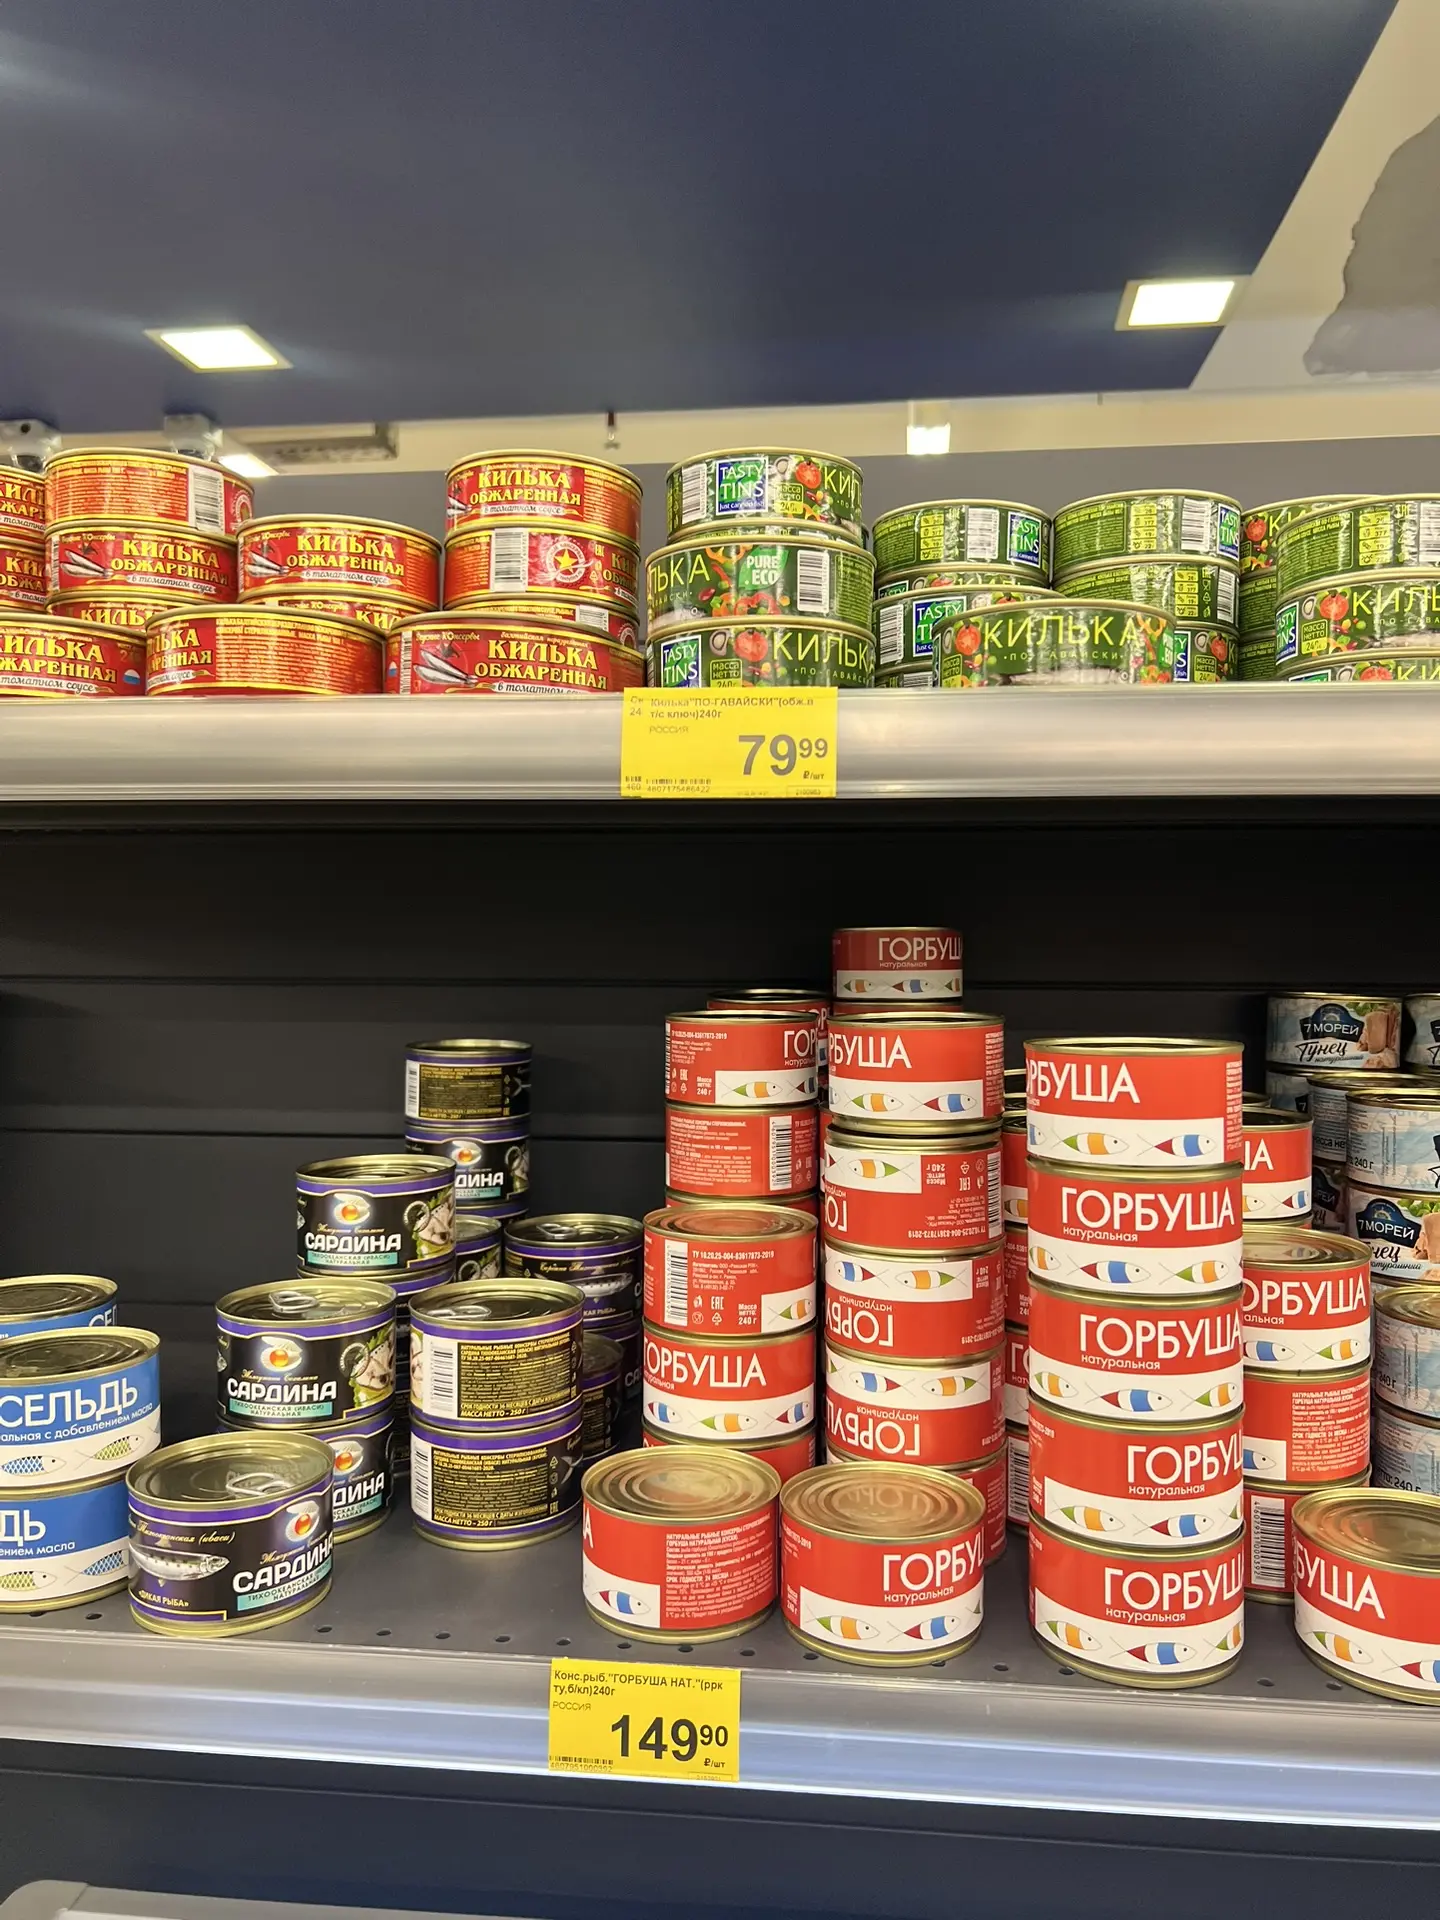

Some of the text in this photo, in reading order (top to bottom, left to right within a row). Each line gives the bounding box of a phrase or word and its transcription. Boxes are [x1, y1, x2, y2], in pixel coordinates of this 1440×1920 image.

[478, 470, 571, 489] КИЛЬКА
[720, 464, 764, 480] TASTY
[470, 489, 581, 506] ОБЖАРЕННАЯ
[719, 481, 765, 500] TINS
[490, 506, 536, 514] томатном
[297, 535, 396, 560] КИЛЬКА
[1011, 533, 1041, 554] TINS
[123, 540, 219, 568] КИЛЬКА
[746, 555, 781, 568] PURE
[111, 558, 228, 586] ОБЖАРЕННАЯ
[286, 554, 405, 577] ОБЖАРЕННАЯ
[139, 575, 190, 589] томатном
[312, 571, 364, 581] томатном
[751, 570, 778, 585] ECO
[984, 615, 1139, 650] КИЛЬКА
[1303, 623, 1326, 634] масса
[488, 639, 598, 670] КИЛЬКА
[663, 644, 698, 662] TASTY
[474, 662, 608, 691] ОБЖАРЕННАЯ
[663, 661, 699, 686] TINS
[667, 709, 723, 720] ключ)240г
[649, 725, 689, 735] РОССИЯ
[879, 961, 929, 971] натуральная
[1303, 1022, 1360, 1036] 7 МОРЕЙ
[1295, 1040, 1349, 1063] Тунец
[1061, 1186, 1235, 1234] ГОРБУША
[1063, 1226, 1139, 1243] натуральная
[1365, 1220, 1415, 1241] МОРЕЙ
[304, 1233, 402, 1253] САРДИНА
[711, 1295, 725, 1311] EAC
[738, 1303, 758, 1311] Масса
[838, 1295, 893, 1312] натуральная
[738, 1316, 752, 1325] 240
[1079, 1307, 1242, 1359] ГОРБУША
[1081, 1353, 1161, 1371] натуральная
[227, 1377, 337, 1404] САРДИНА
[0, 1377, 138, 1428] СЕЛЬДЬ
[54, 1413, 131, 1441] добавлением
[131, 1402, 154, 1419] масла
[250, 1409, 302, 1418] НАТУРАЛЬНАЯ
[481, 1410, 505, 1418] НЕТТО
[856, 1405, 919, 1422] натуральная
[1128, 1483, 1206, 1500] натуральная
[36, 1540, 76, 1556] масла
[162, 1596, 190, 1609] РЫБА»
[884, 1586, 955, 1606] натуральная
[1105, 1607, 1187, 1625] натуральная
[552, 1700, 592, 1712] РОССИЯ
